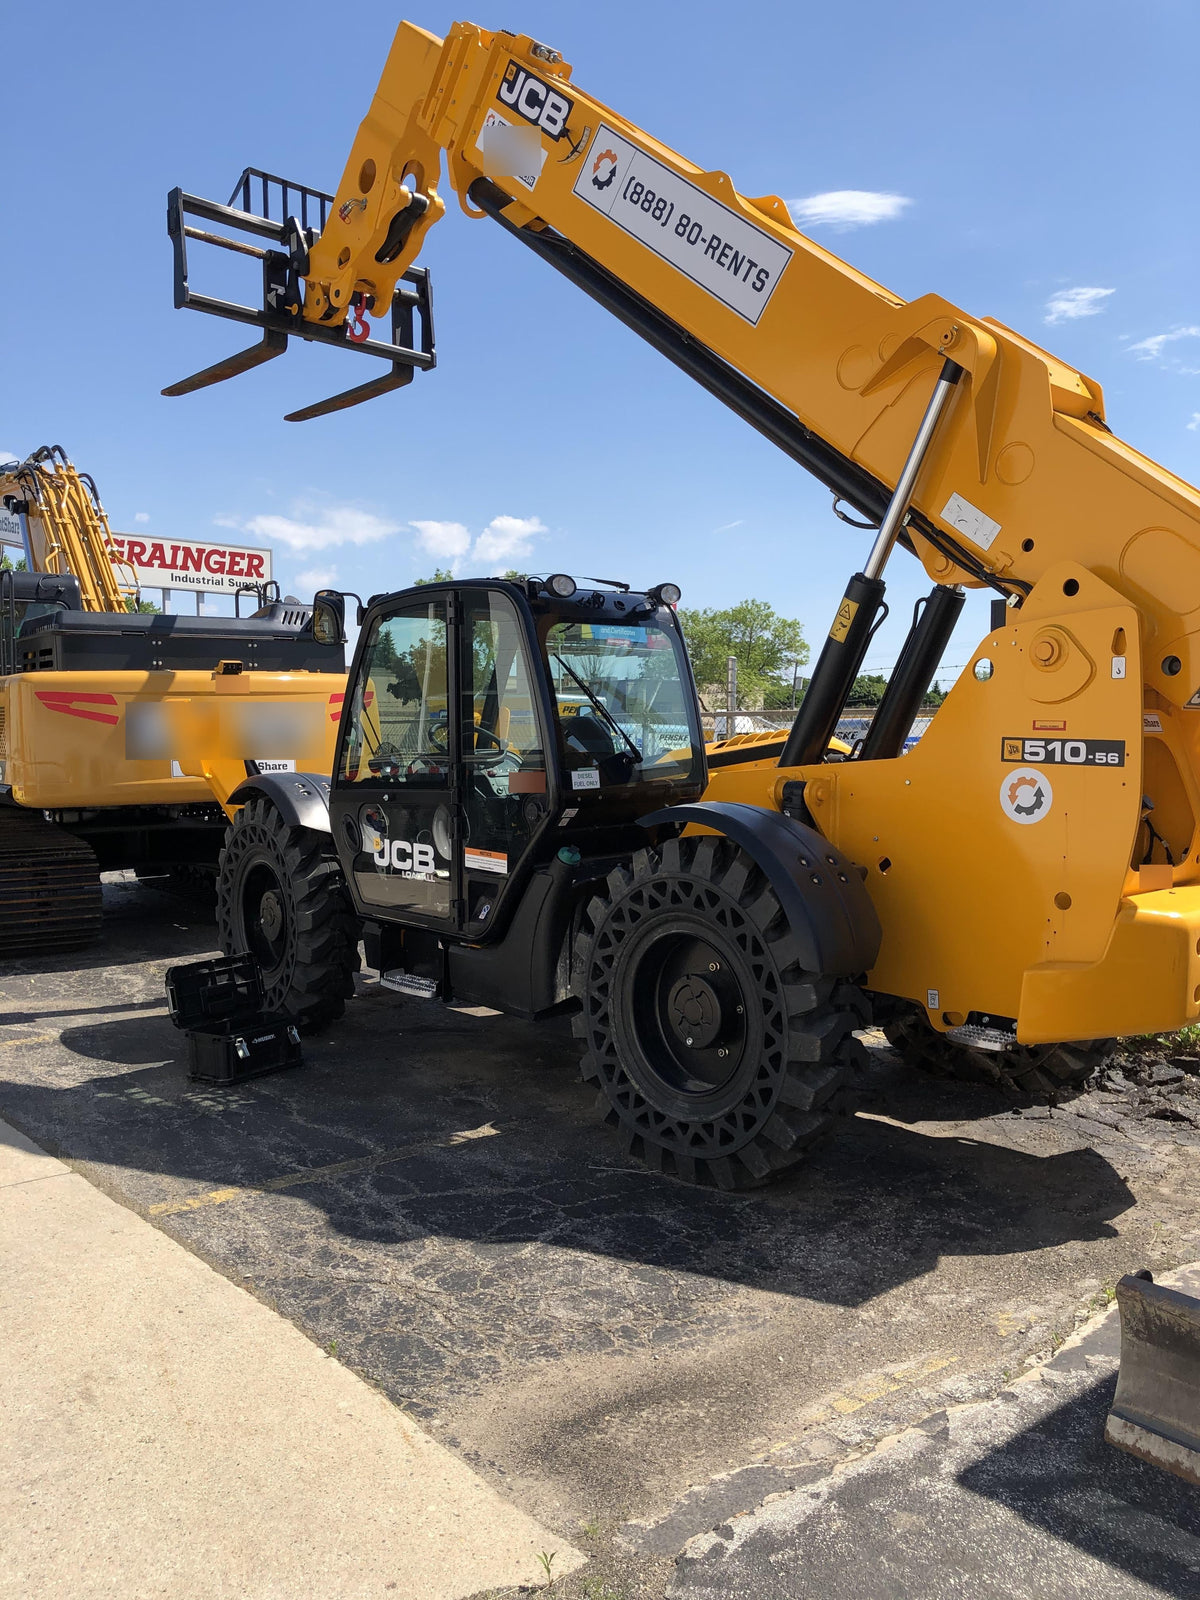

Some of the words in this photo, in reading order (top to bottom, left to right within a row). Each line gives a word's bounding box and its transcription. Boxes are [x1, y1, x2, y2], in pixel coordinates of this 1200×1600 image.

[500, 71, 569, 136] JCB
[622, 176, 675, 227] (888)
[674, 213, 770, 293] 80-RENTS
[103, 537, 265, 579] GRAINGER
[170, 572, 224, 587] Industrial
[659, 733, 689, 742] PENSKE
[258, 761, 288, 771] Share
[374, 838, 436, 873] JCB
